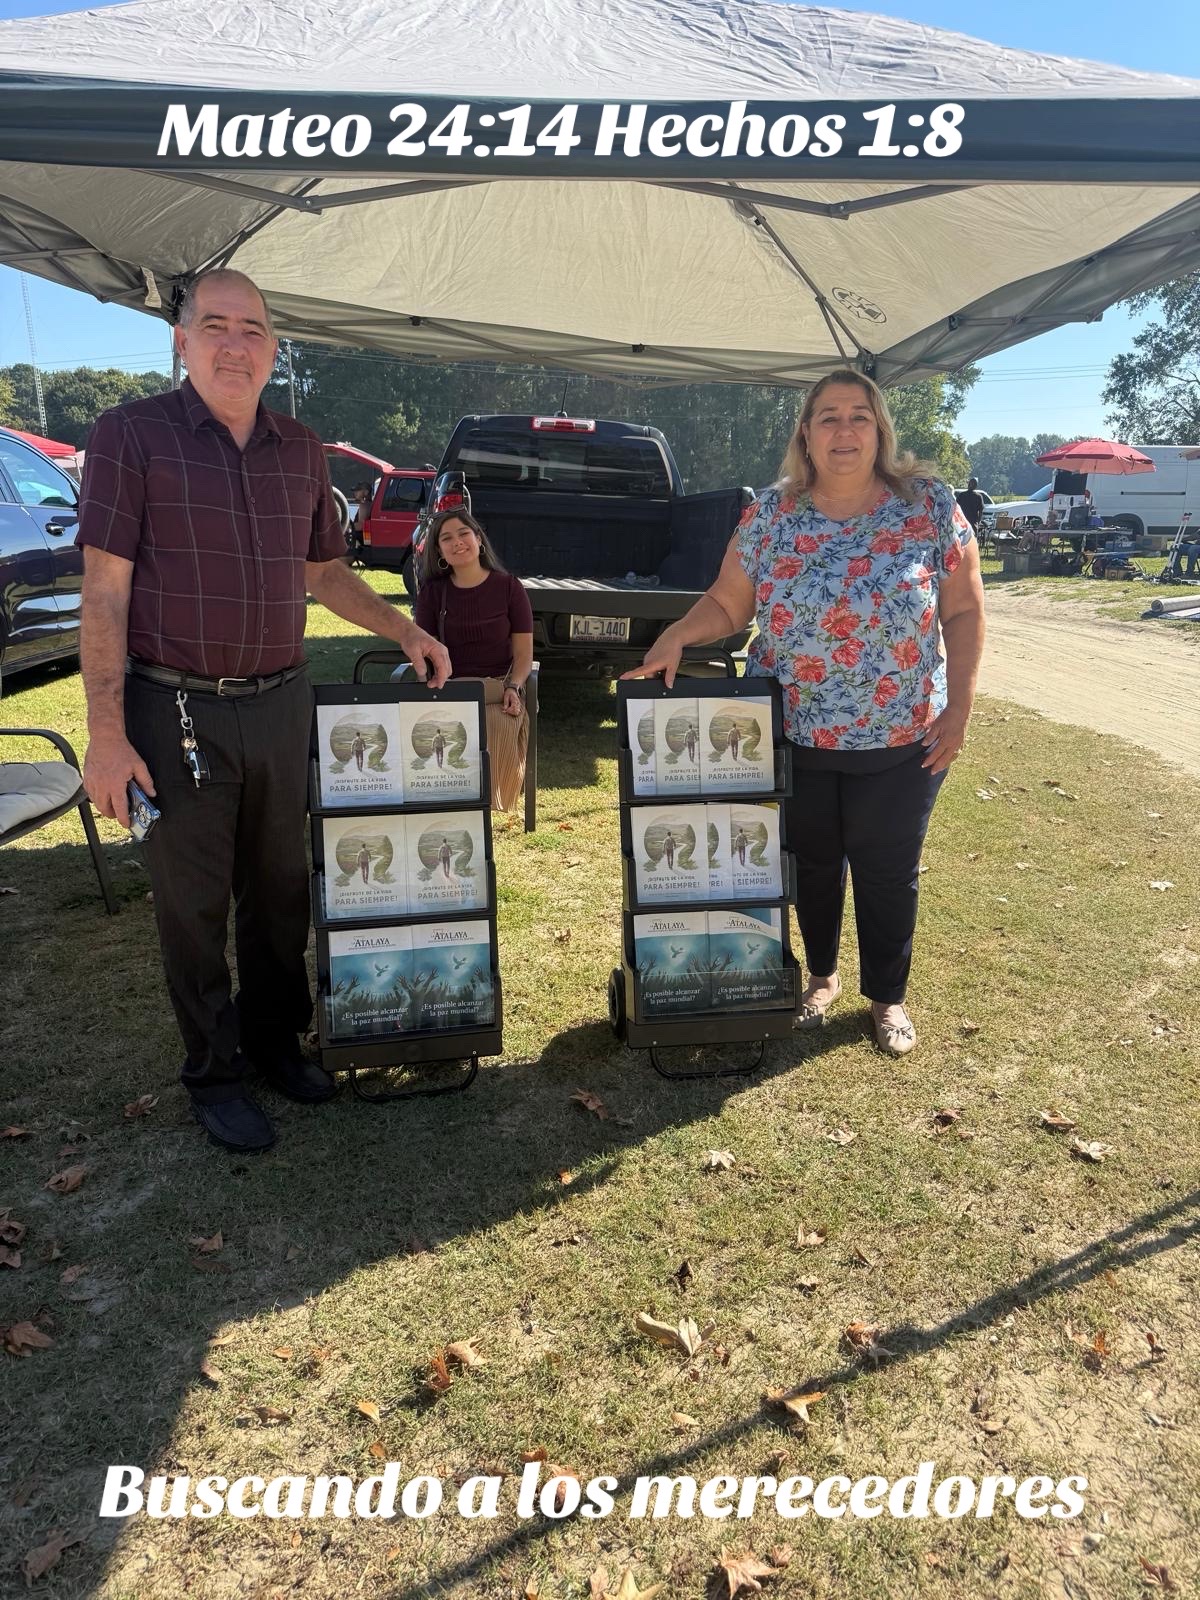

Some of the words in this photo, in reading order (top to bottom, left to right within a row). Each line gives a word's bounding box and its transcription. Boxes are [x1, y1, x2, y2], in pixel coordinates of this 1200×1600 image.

[573, 620, 626, 636] KJL-1440
[354, 783, 393, 791] SIEMPRE!
[643, 882, 664, 890] PARA
[665, 881, 700, 889] SIEMPRE!
[737, 877, 772, 886] SIEMPRE!
[441, 889, 478, 898] SIEMPRE!
[360, 895, 398, 904] SIEMPRE!
[653, 922, 685, 930] ATALAYA
[729, 919, 761, 929] ATALAYA
[434, 931, 468, 941] ATALAYA
[354, 937, 390, 947] ATALAYA
[643, 992, 652, 1000] ¿Es
[652, 990, 674, 999] posible
[674, 988, 701, 996] alcanzar
[718, 987, 728, 995] ¿Es
[728, 985, 751, 993] posible
[751, 984, 777, 992] alcanzar
[668, 995, 696, 1003] mundial?
[744, 991, 772, 999] mundial?
[421, 1003, 432, 1012] ¿Es
[433, 1001, 457, 1011] posible
[429, 1009, 436, 1017] la
[450, 1006, 480, 1015] mundial?
[341, 1012, 354, 1020] ¿Es
[354, 1008, 379, 1020] posible
[380, 1006, 409, 1015] alcanzar
[351, 1018, 358, 1026] la
[372, 1013, 403, 1023] mundial?
